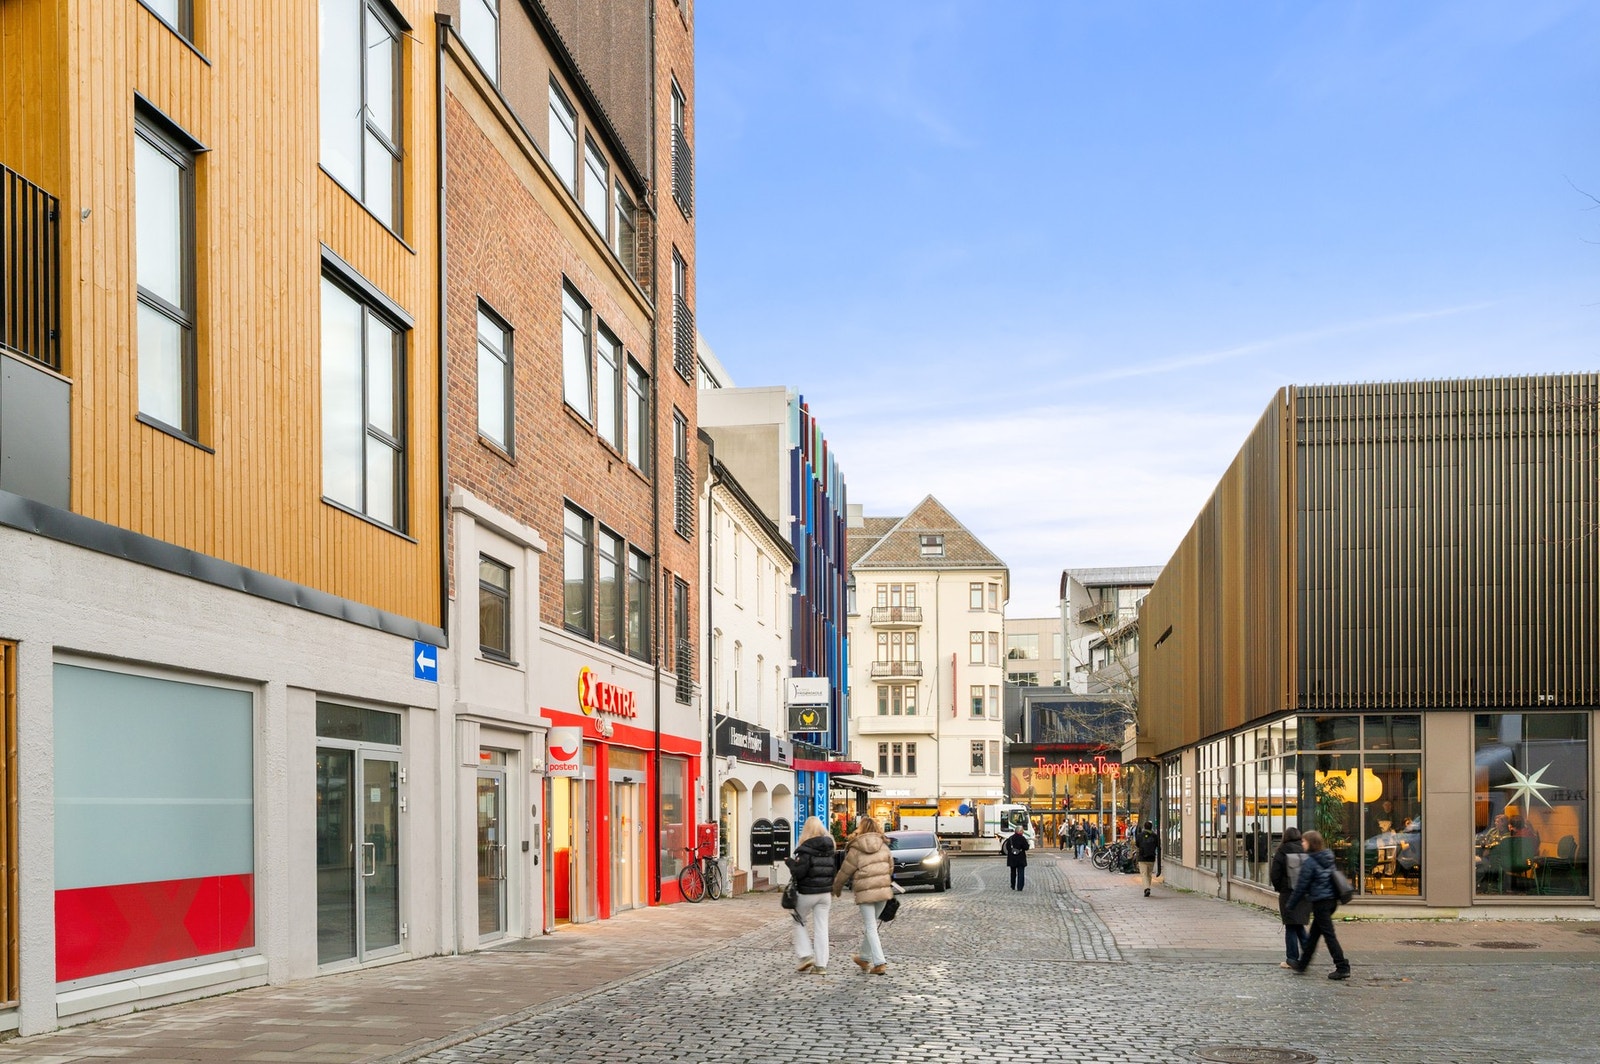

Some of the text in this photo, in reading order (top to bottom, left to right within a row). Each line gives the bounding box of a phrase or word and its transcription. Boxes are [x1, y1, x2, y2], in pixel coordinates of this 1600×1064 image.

[600, 682, 637, 718] EXTRA
[549, 763, 578, 772] posten
[1034, 756, 1120, 779] Trondheim Torg
